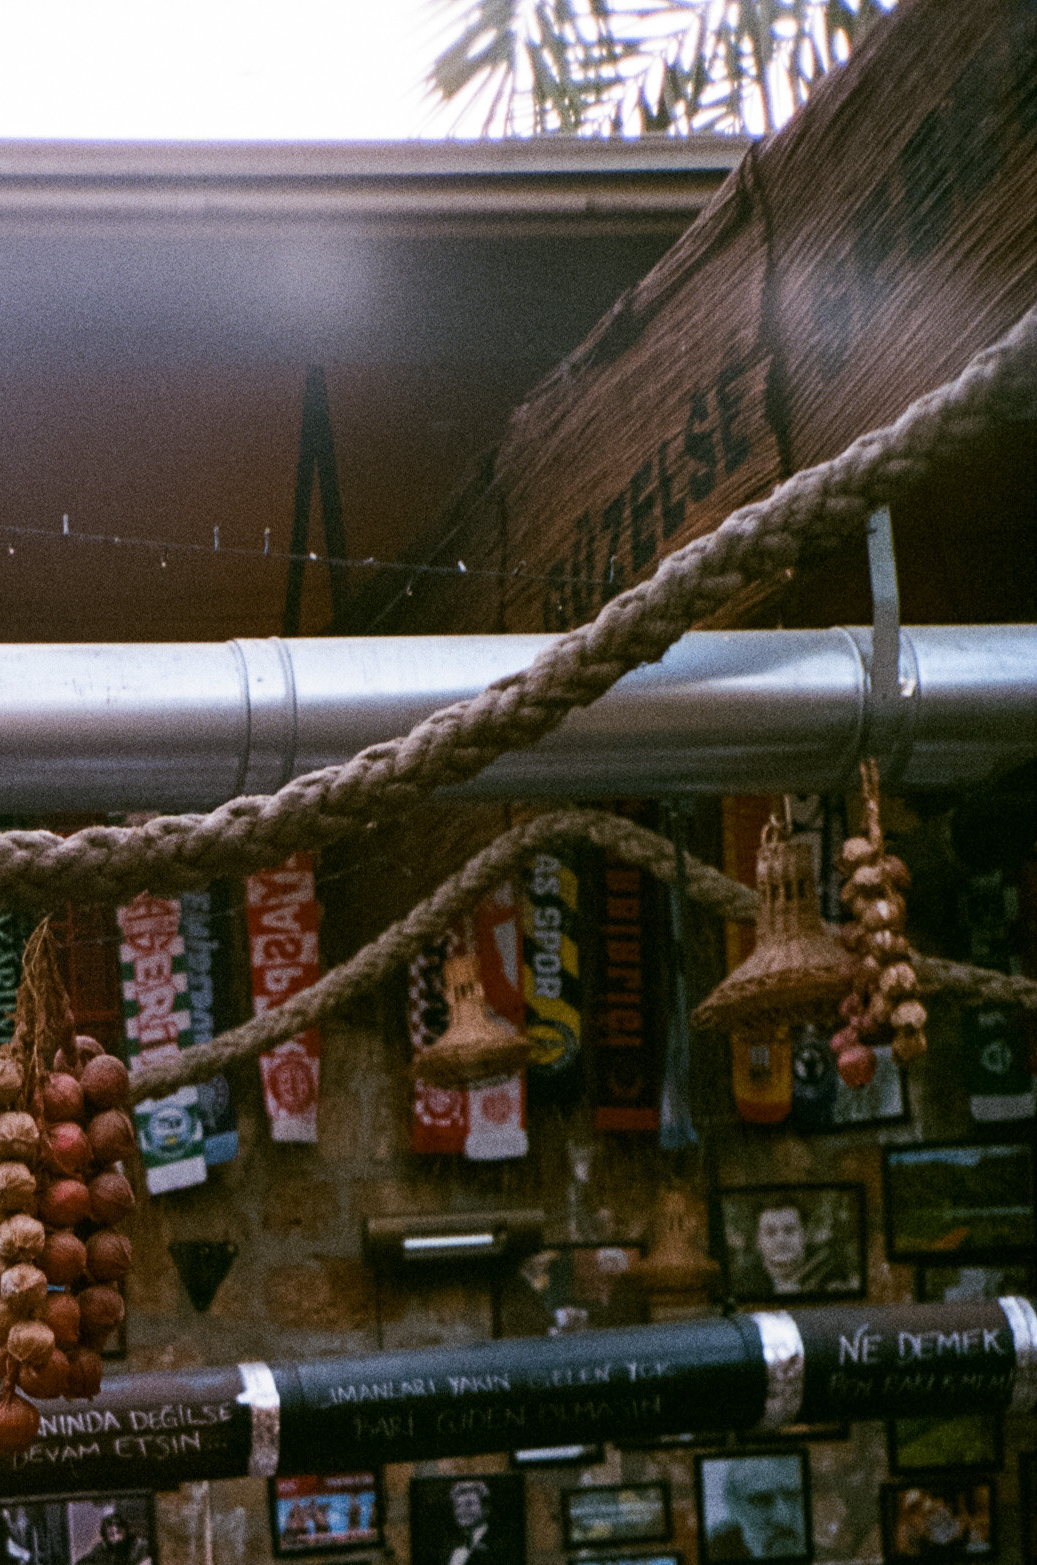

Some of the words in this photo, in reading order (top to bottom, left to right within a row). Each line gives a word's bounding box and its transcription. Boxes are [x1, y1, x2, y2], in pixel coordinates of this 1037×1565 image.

[533, 905, 563, 1000] SPOR
[838, 1323, 883, 1366] NE
[36, 1410, 122, 1438] NINDA
